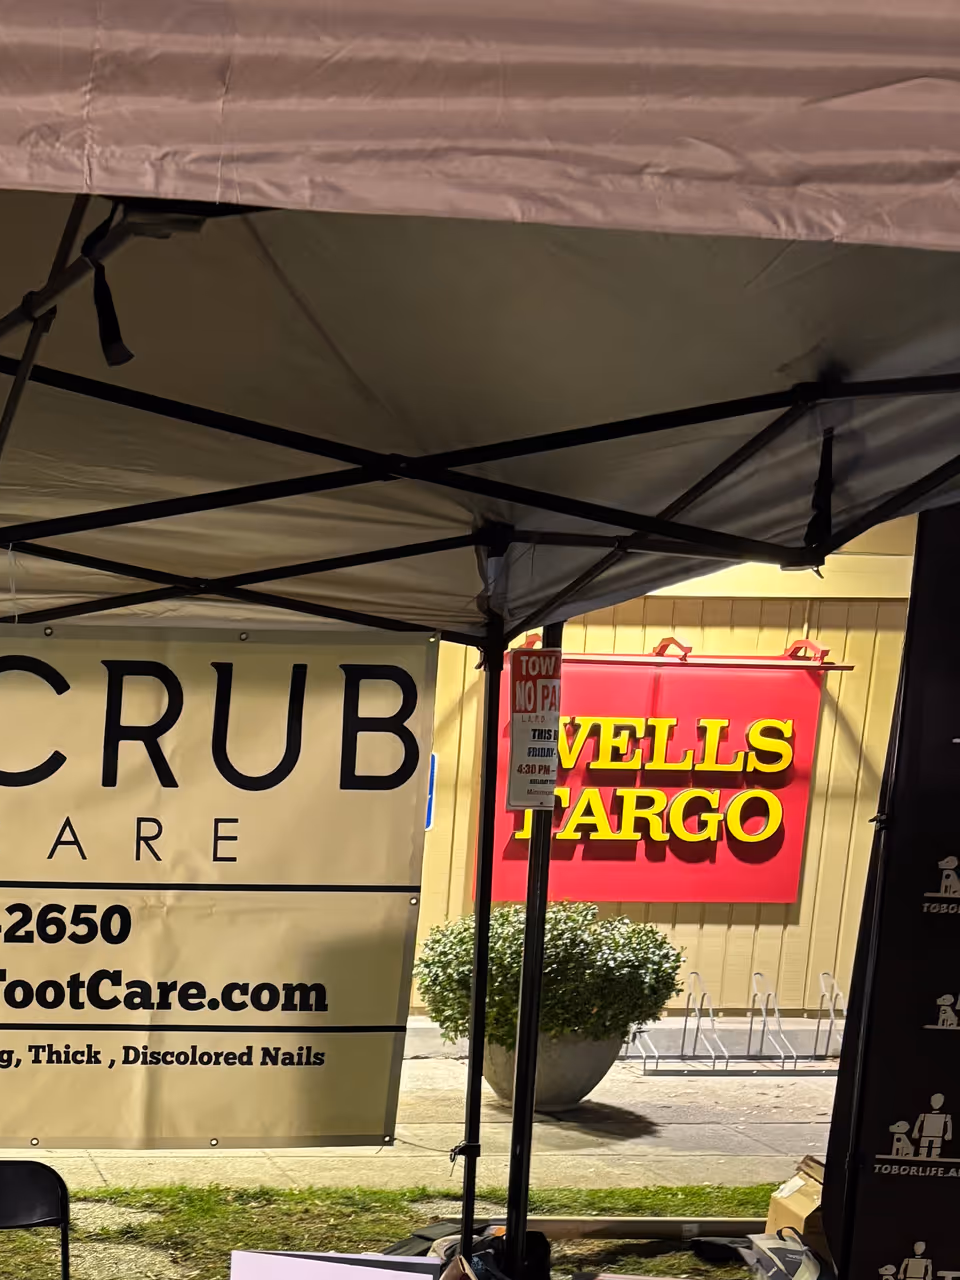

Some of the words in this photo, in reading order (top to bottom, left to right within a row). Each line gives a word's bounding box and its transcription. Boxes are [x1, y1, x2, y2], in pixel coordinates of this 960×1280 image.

[520, 656, 556, 675] TOW
[515, 681, 535, 711] NO
[542, 684, 561, 711] PA
[530, 729, 553, 741] THIS
[517, 764, 536, 775] 4:30
[28, 1044, 102, 1066] Thick
[122, 1045, 254, 1067] Discolored
[260, 1046, 325, 1067] Nails
